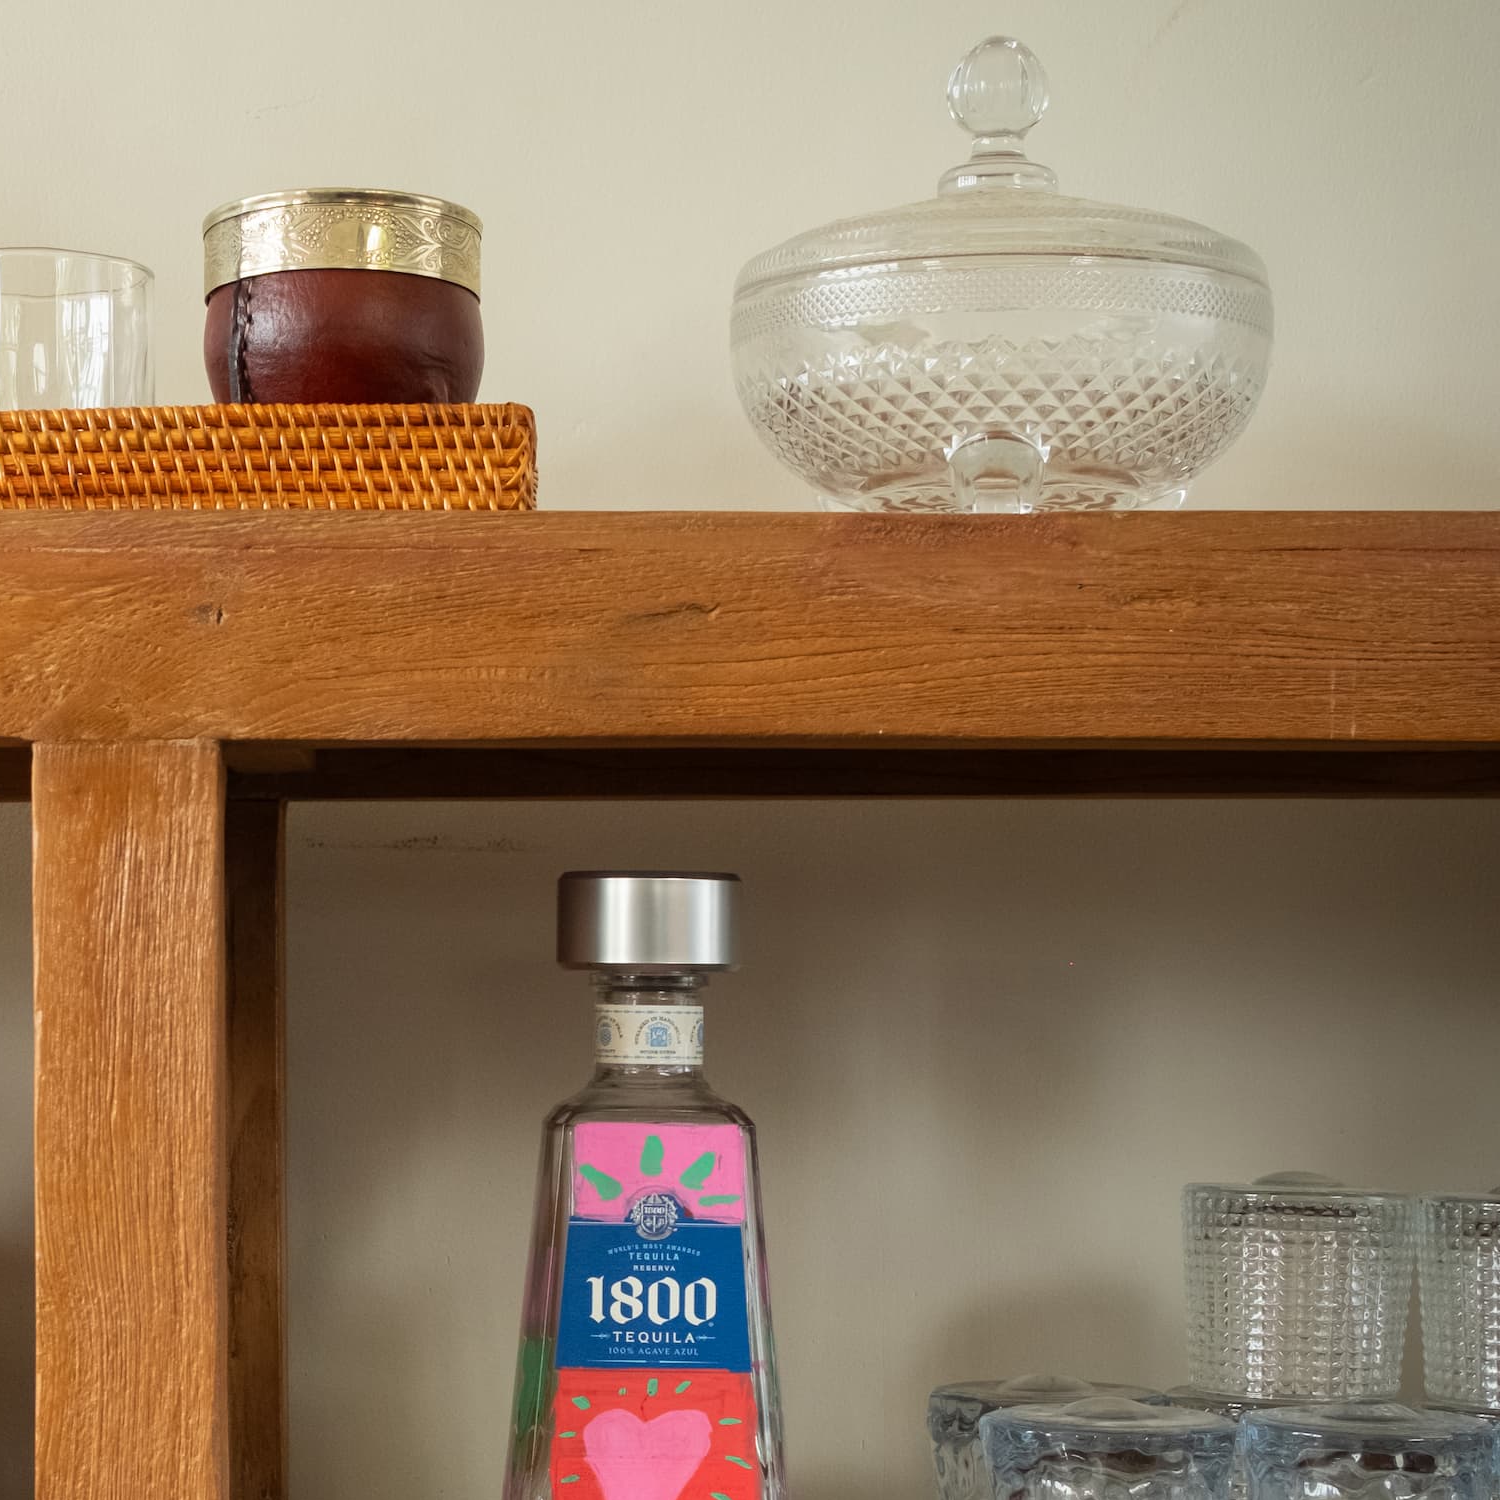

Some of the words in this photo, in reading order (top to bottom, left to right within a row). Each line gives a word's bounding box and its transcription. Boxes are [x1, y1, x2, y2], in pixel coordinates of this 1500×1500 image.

[628, 1252, 680, 1261] TEQUILA
[633, 1264, 676, 1272] RESERVA
[586, 1275, 717, 1327] 1800
[612, 1331, 696, 1344] TEQUILA
[608, 1346, 634, 1355] 100%
[638, 1347, 671, 1356] AGAVE
[674, 1348, 699, 1356] AZUL
